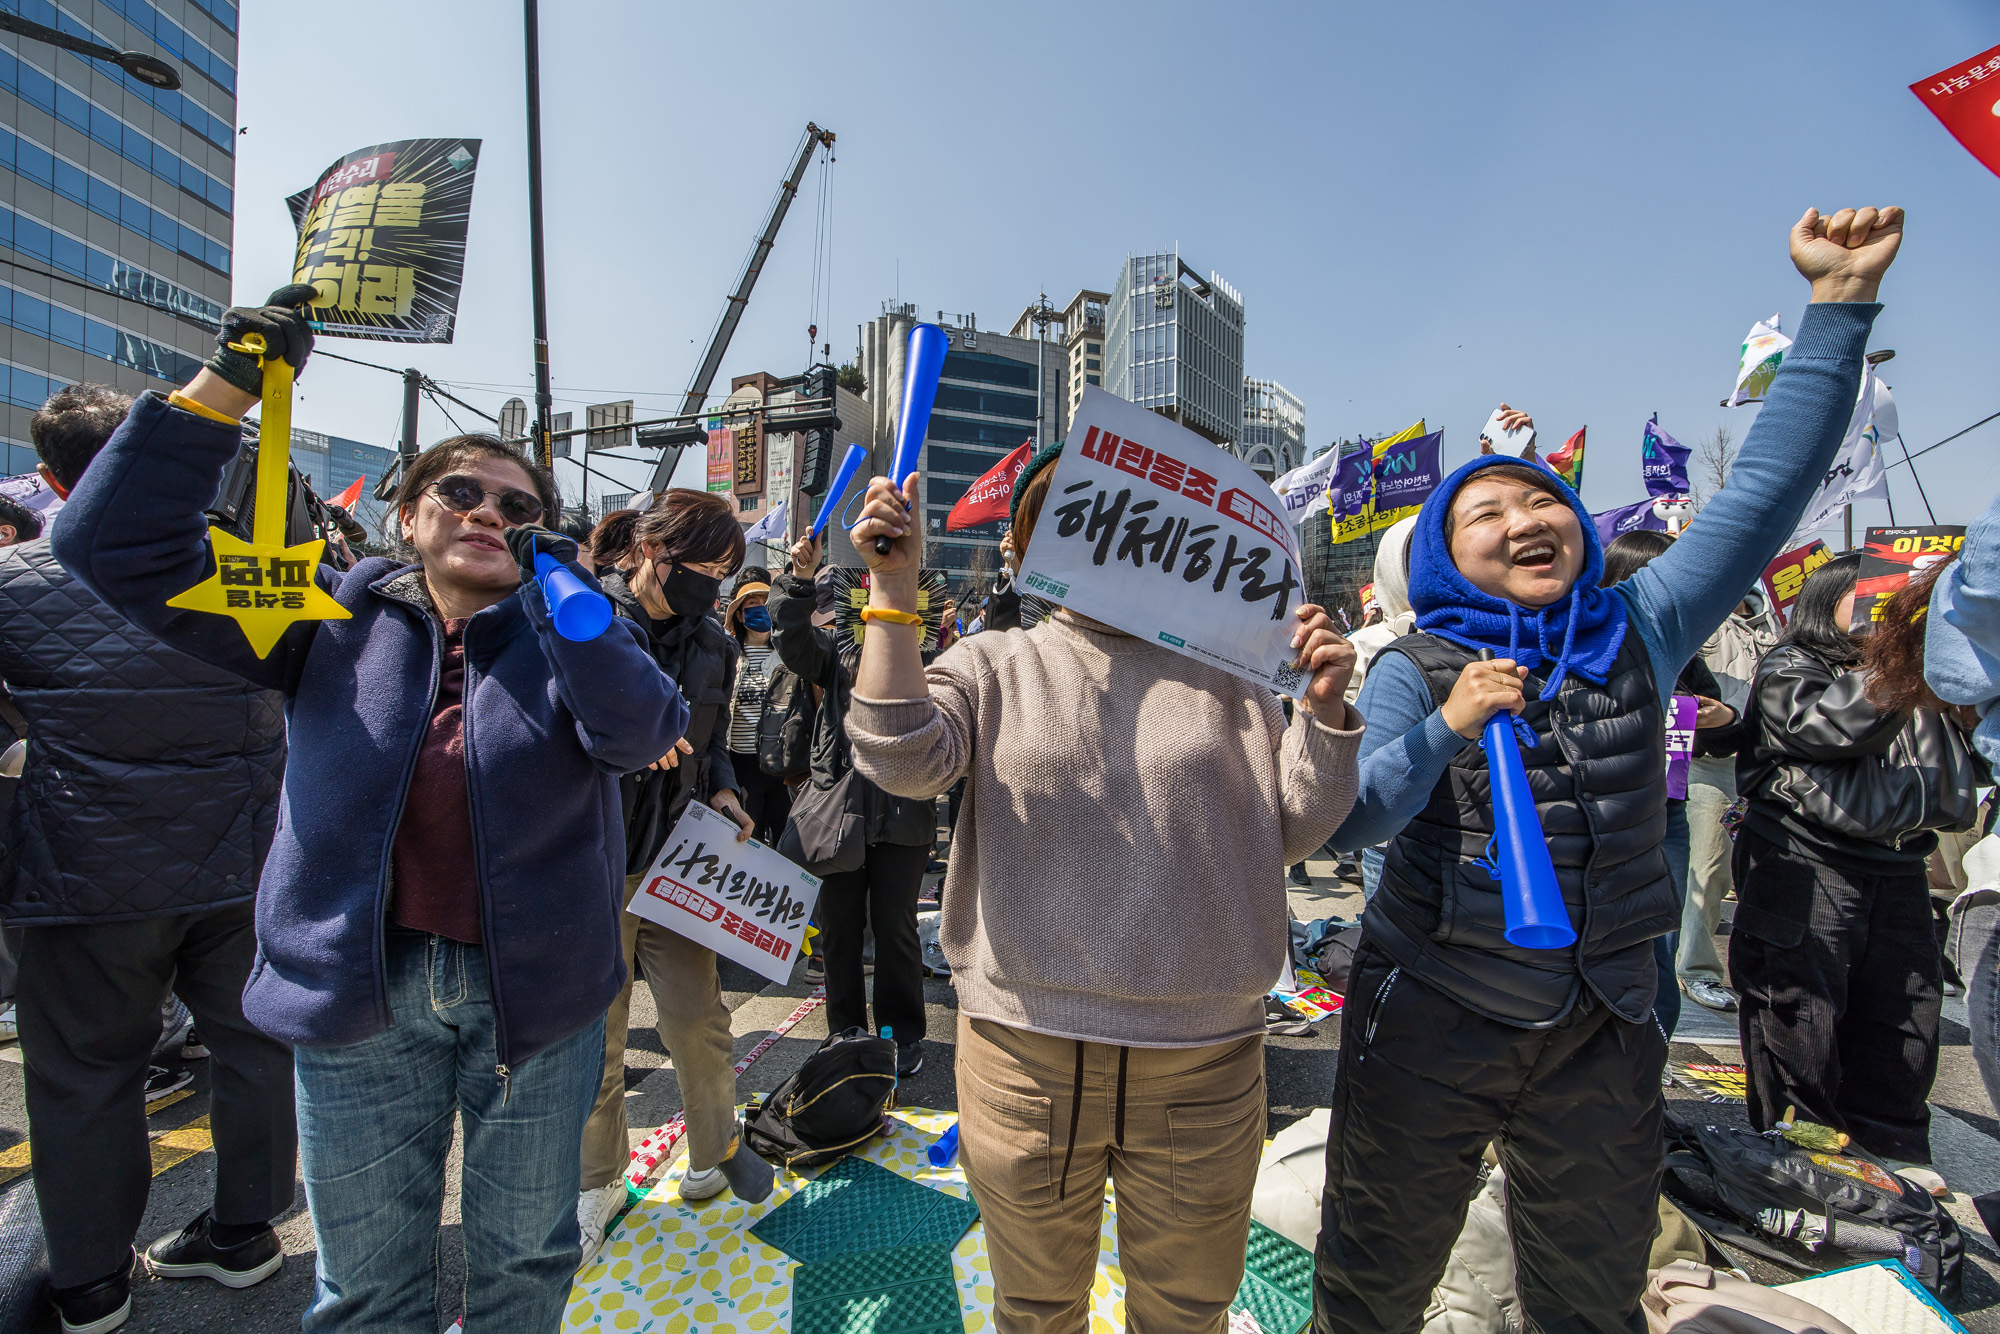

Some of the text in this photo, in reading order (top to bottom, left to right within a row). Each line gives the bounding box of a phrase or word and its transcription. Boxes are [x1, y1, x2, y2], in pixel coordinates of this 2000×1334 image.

[293, 262, 415, 317] 하라
[1080, 425, 1218, 508] 내란동조
[219, 554, 311, 588] 파면
[1054, 480, 1299, 621] 해체하라
[226, 589, 306, 609] 윤석열
[1025, 575, 1069, 599] 비상행동
[660, 838, 806, 930] 해체하라!
[654, 877, 793, 963] 내란동조 국민의힘
[743, 1038, 776, 1063] DANGER
